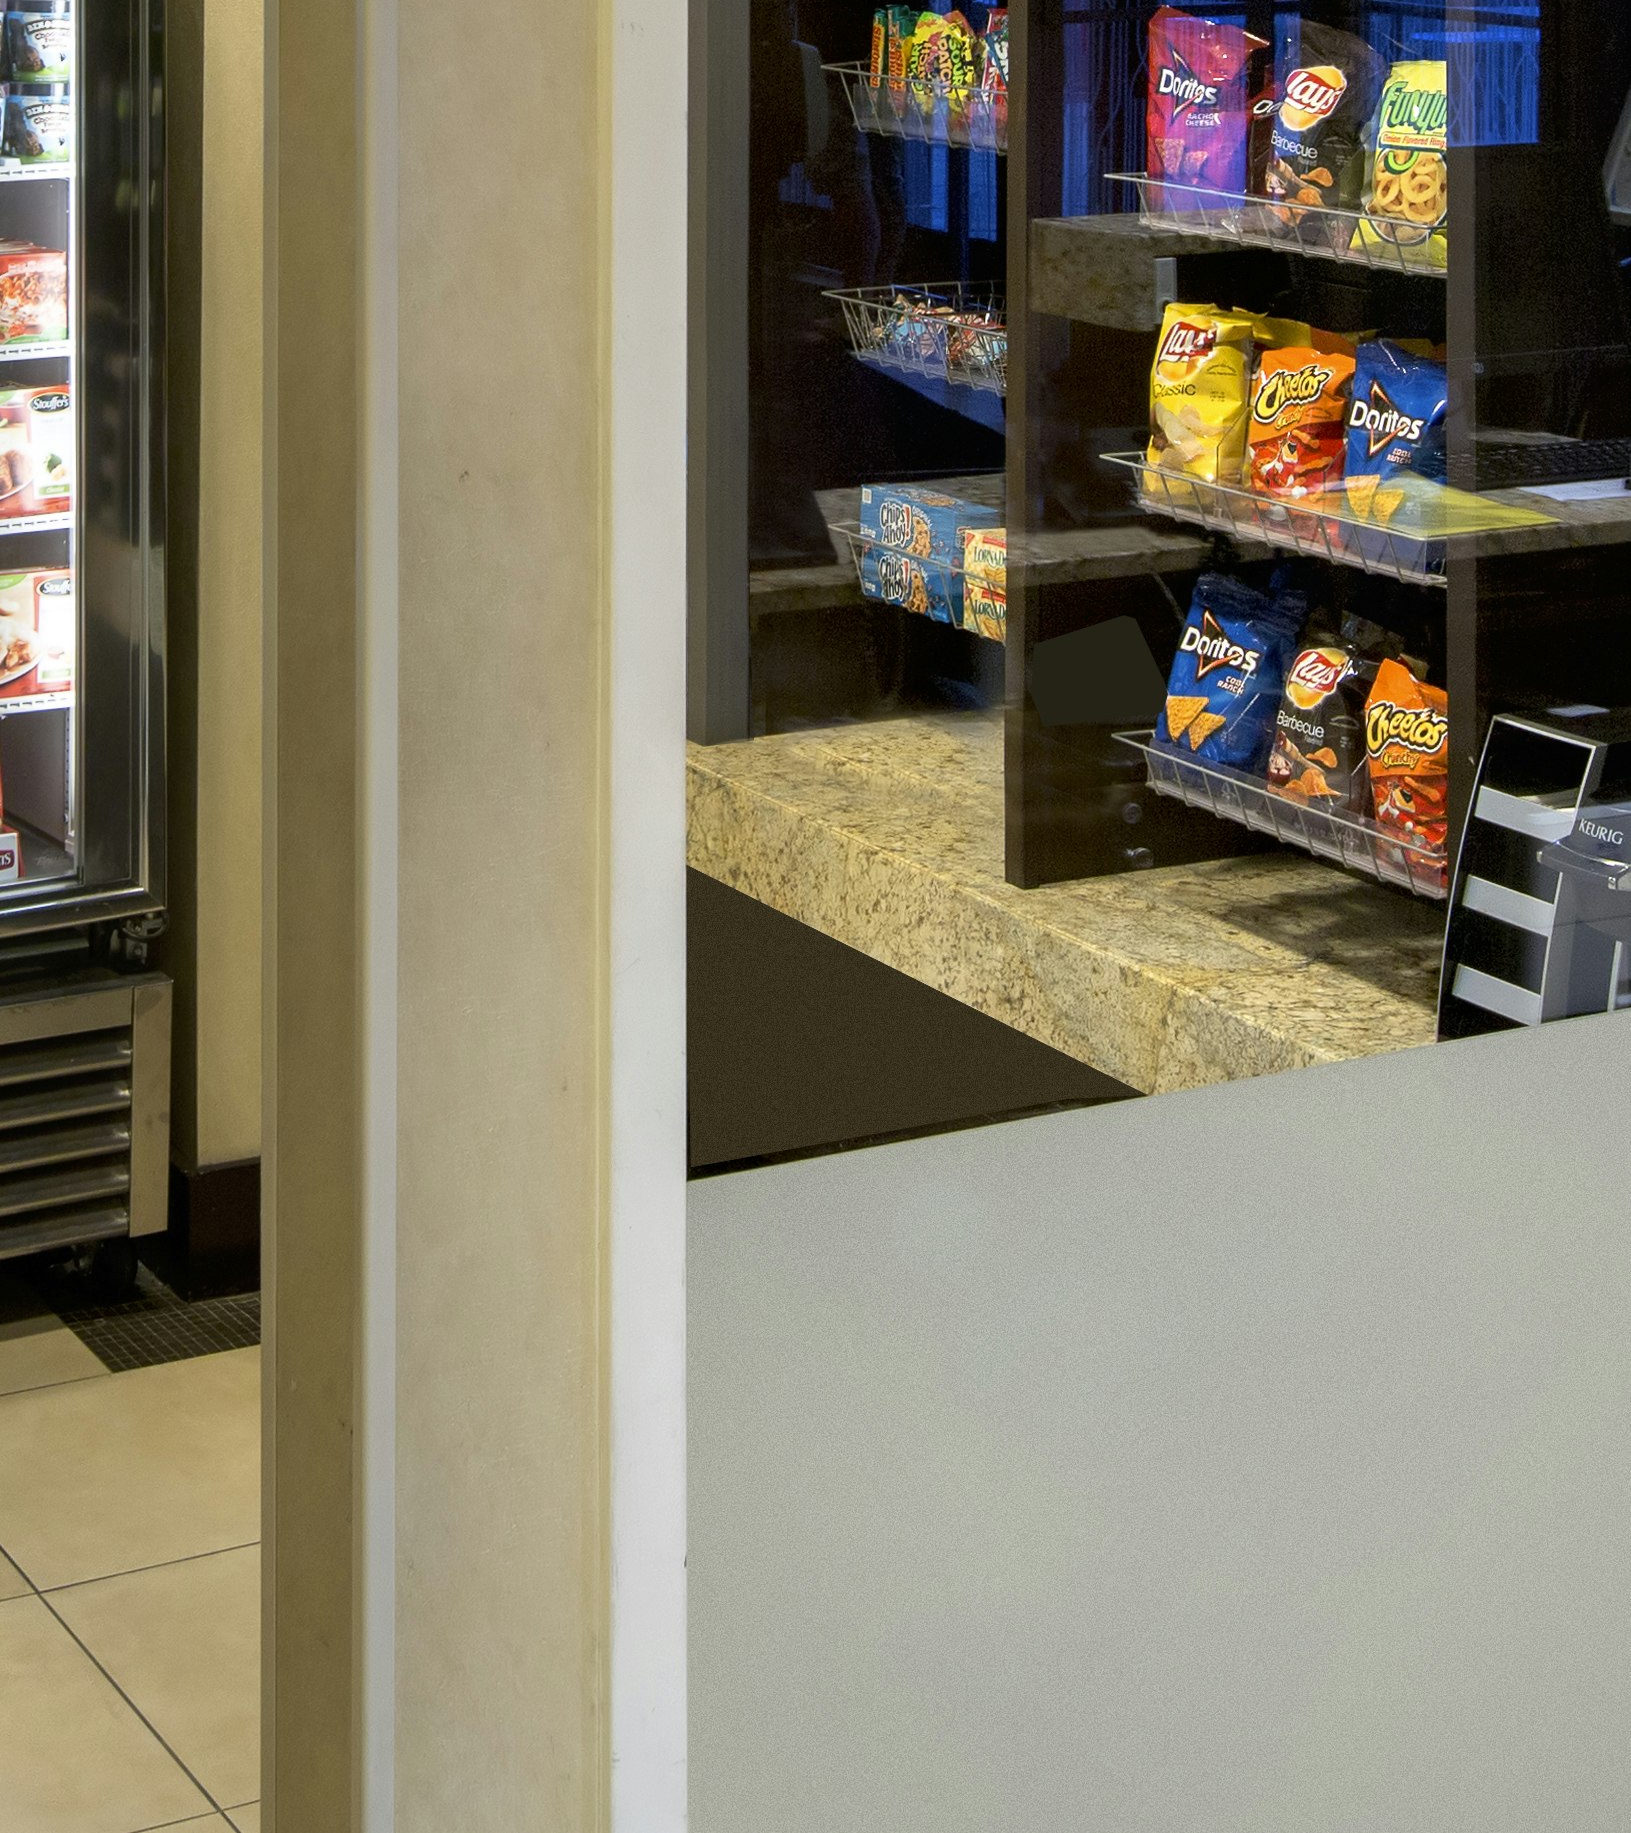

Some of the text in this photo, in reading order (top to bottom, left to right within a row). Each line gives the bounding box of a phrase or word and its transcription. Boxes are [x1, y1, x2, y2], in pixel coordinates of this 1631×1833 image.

[937, 38, 954, 94] PATCH
[949, 38, 965, 86] SOUR
[1158, 68, 1218, 105] Doritos
[1285, 71, 1343, 113] Lay's
[1380, 81, 1447, 134] Funyu
[1271, 130, 1318, 159] Barbecue
[1402, 136, 1428, 145] Flavored
[33, 397, 69, 410] Stouffer's
[1154, 382, 1196, 399] Classic
[1256, 366, 1334, 423] Cheetos
[1349, 400, 1424, 441] Doritos
[881, 504, 905, 527] Chips
[880, 558, 905, 580] Chips
[1180, 627, 1258, 671] Doritos
[1217, 680, 1244, 694] RANCH
[1226, 675, 1245, 686] COOL
[1291, 652, 1341, 691] Lay's
[1277, 710, 1324, 737] Barbecue
[1367, 703, 1447, 751] Cheetos
[1579, 819, 1624, 845] KEURIG
